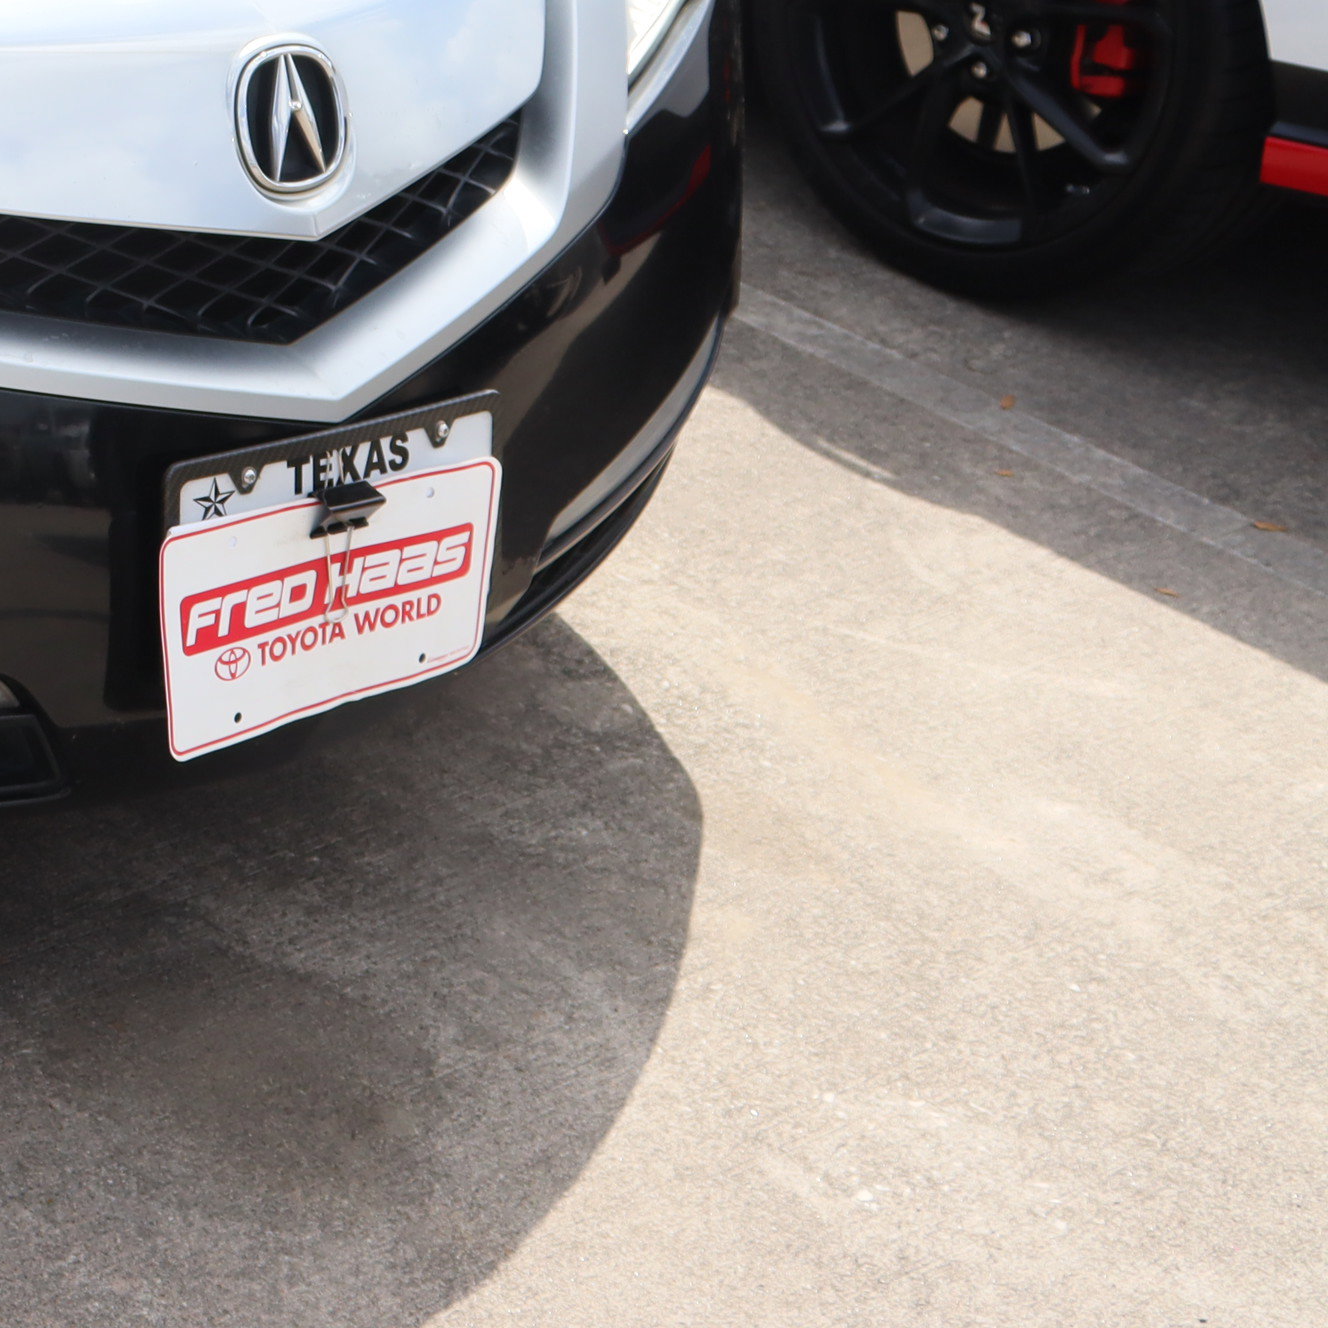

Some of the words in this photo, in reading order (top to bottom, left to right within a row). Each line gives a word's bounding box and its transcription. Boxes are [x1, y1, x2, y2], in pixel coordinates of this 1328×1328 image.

[287, 432, 410, 495] TEXAS
[257, 620, 346, 666] TOYOTA
[354, 592, 442, 635] WORLD
